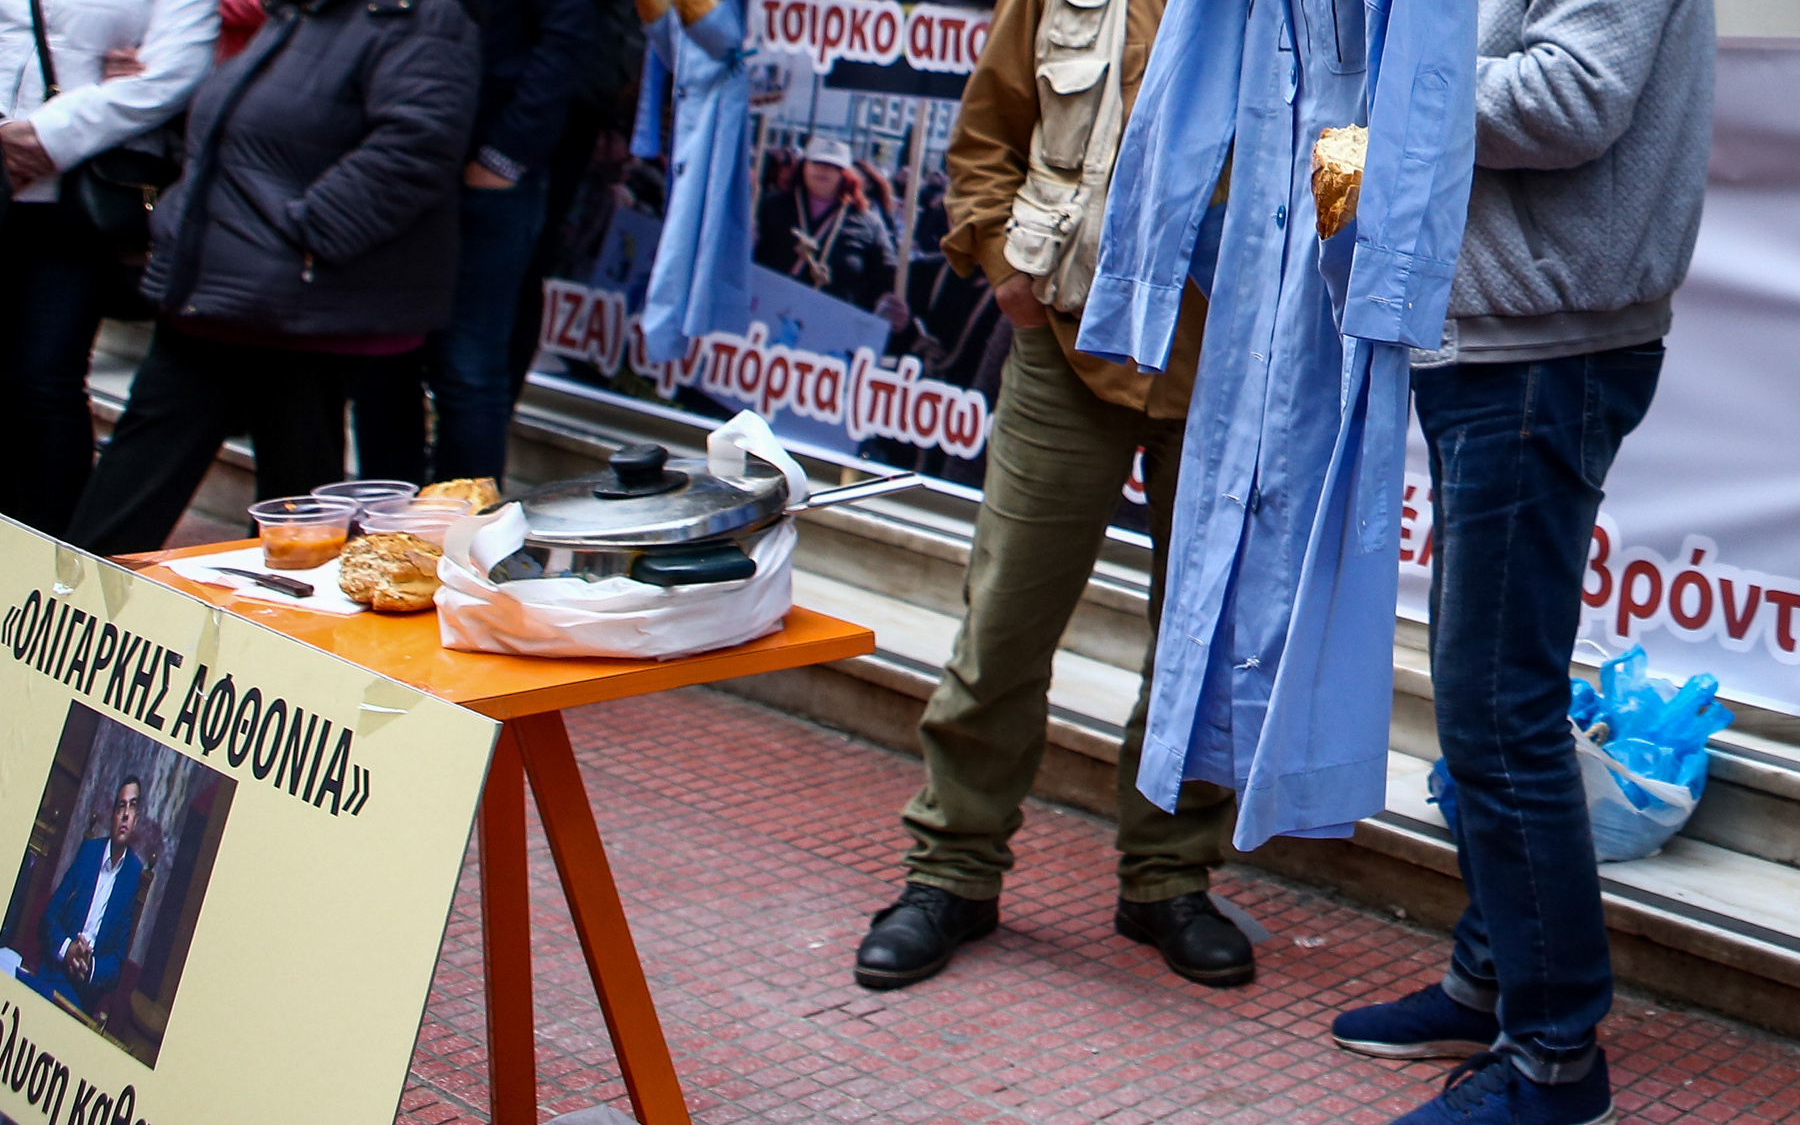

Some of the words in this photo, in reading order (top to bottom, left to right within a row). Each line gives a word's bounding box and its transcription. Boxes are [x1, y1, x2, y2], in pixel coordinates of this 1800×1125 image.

[711, 333, 842, 415] πόρτα
[853, 358, 979, 448] (πίσω
[170, 663, 370, 817] ΑΦΘΟΝΙΑ»
